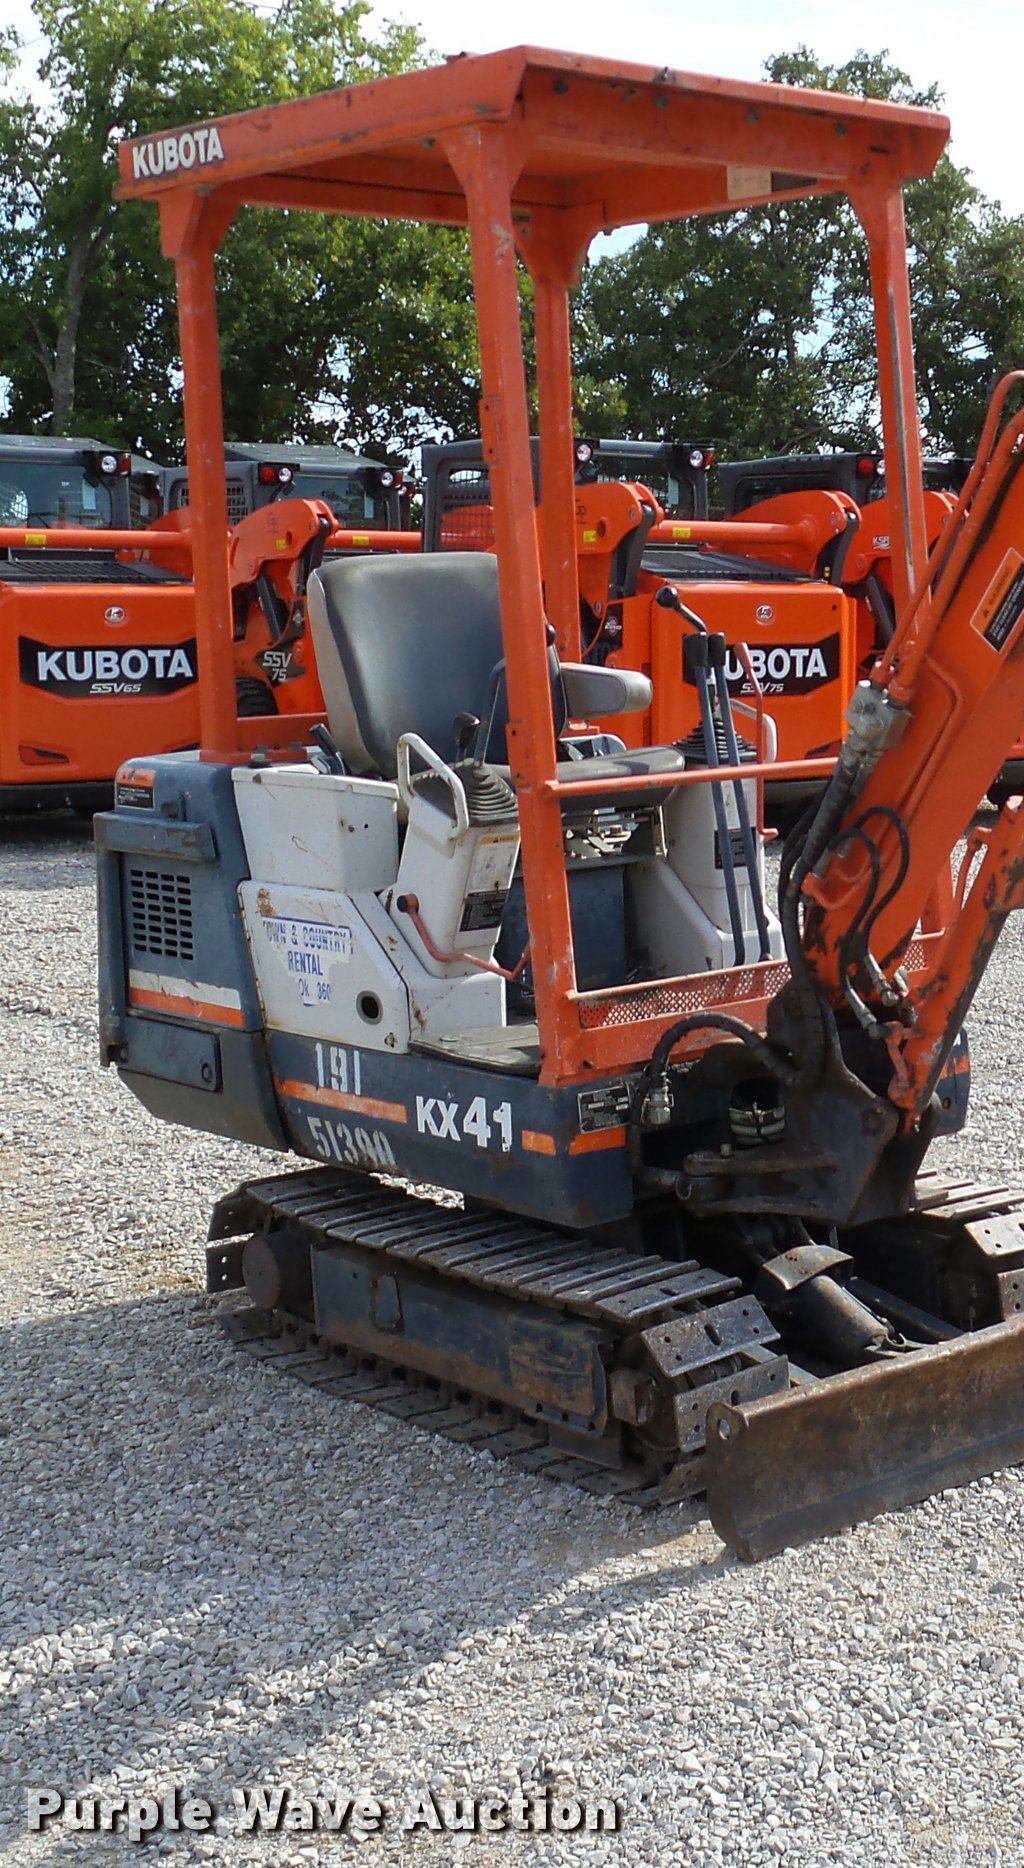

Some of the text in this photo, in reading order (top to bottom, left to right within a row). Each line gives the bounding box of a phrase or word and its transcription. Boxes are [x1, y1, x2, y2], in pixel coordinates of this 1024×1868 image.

[132, 127, 224, 179] KUBOTA
[37, 649, 194, 682] KUBOTA
[262, 651, 293, 669] SSV
[271, 668, 287, 682] 75
[705, 647, 828, 685] UBOTA
[89, 682, 142, 694] SSV65
[287, 950, 324, 977] RENTAL
[415, 1095, 513, 1153] KX41
